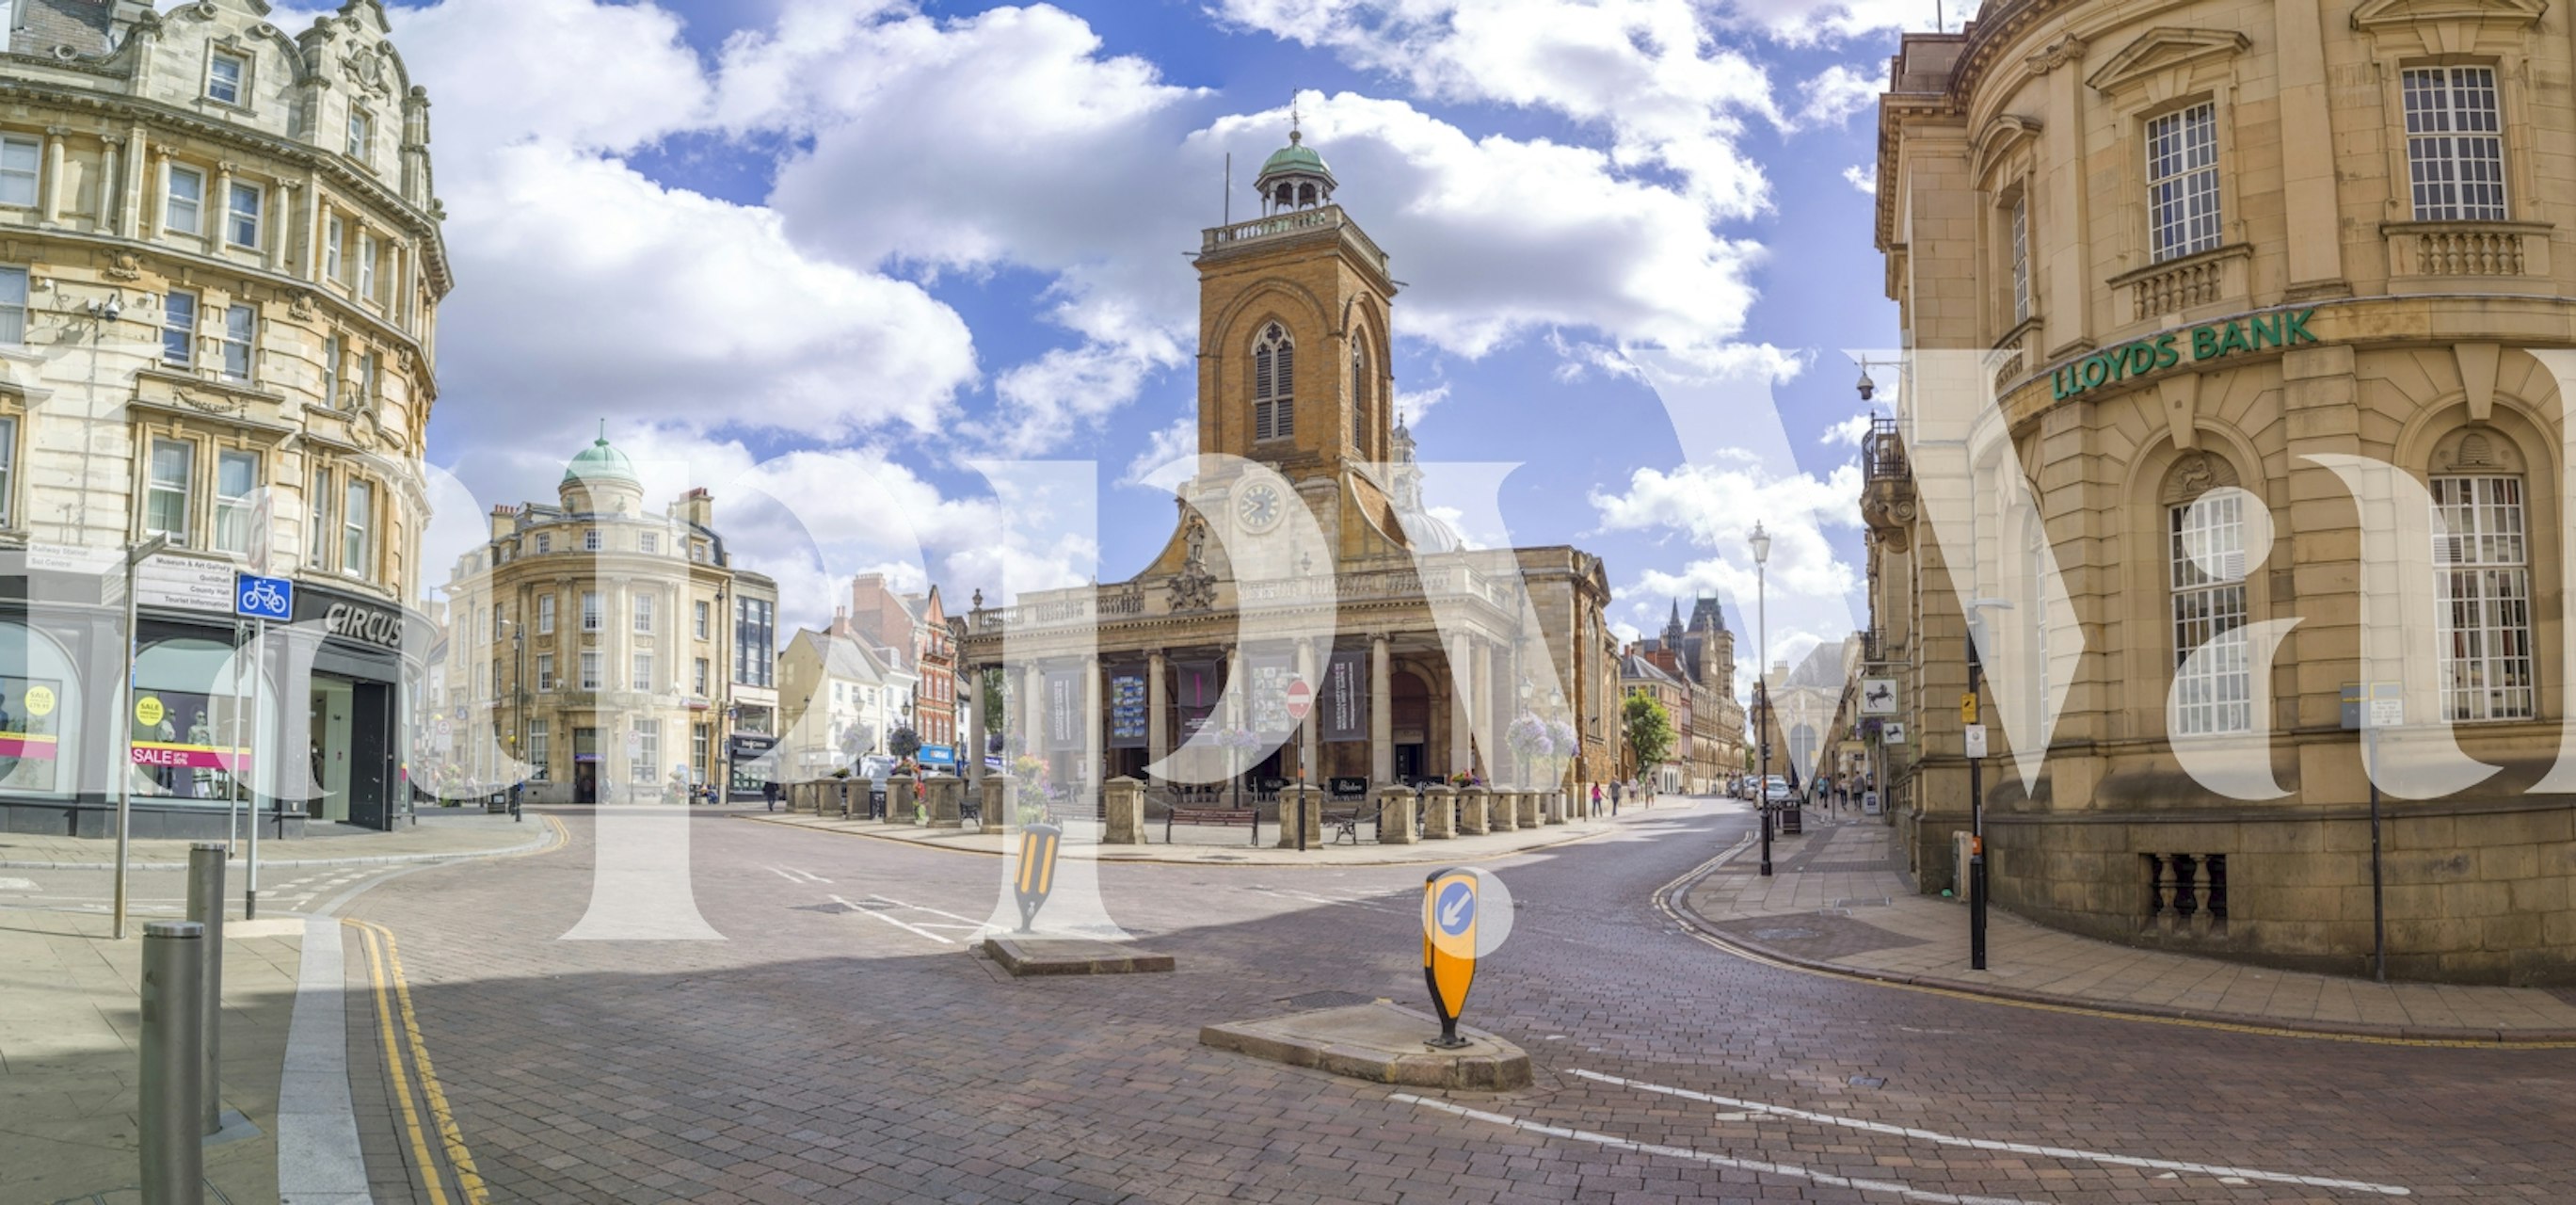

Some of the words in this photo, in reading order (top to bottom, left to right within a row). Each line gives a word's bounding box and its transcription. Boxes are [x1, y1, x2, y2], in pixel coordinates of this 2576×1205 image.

[2051, 334, 2179, 401] LLOYDS
[2191, 309, 2317, 361] BANK
[32, 544, 60, 554] Railway
[62, 548, 88, 557] Station
[156, 556, 186, 567] Museum
[206, 562, 231, 573] Gallery
[200, 573, 231, 584] Guildhall
[189, 586, 215, 596] County
[165, 595, 189, 604] Tourist
[190, 598, 230, 610] Information
[325, 602, 406, 646] CIRCUS
[140, 702, 159, 711] SALE
[133, 748, 172, 765] SALE
